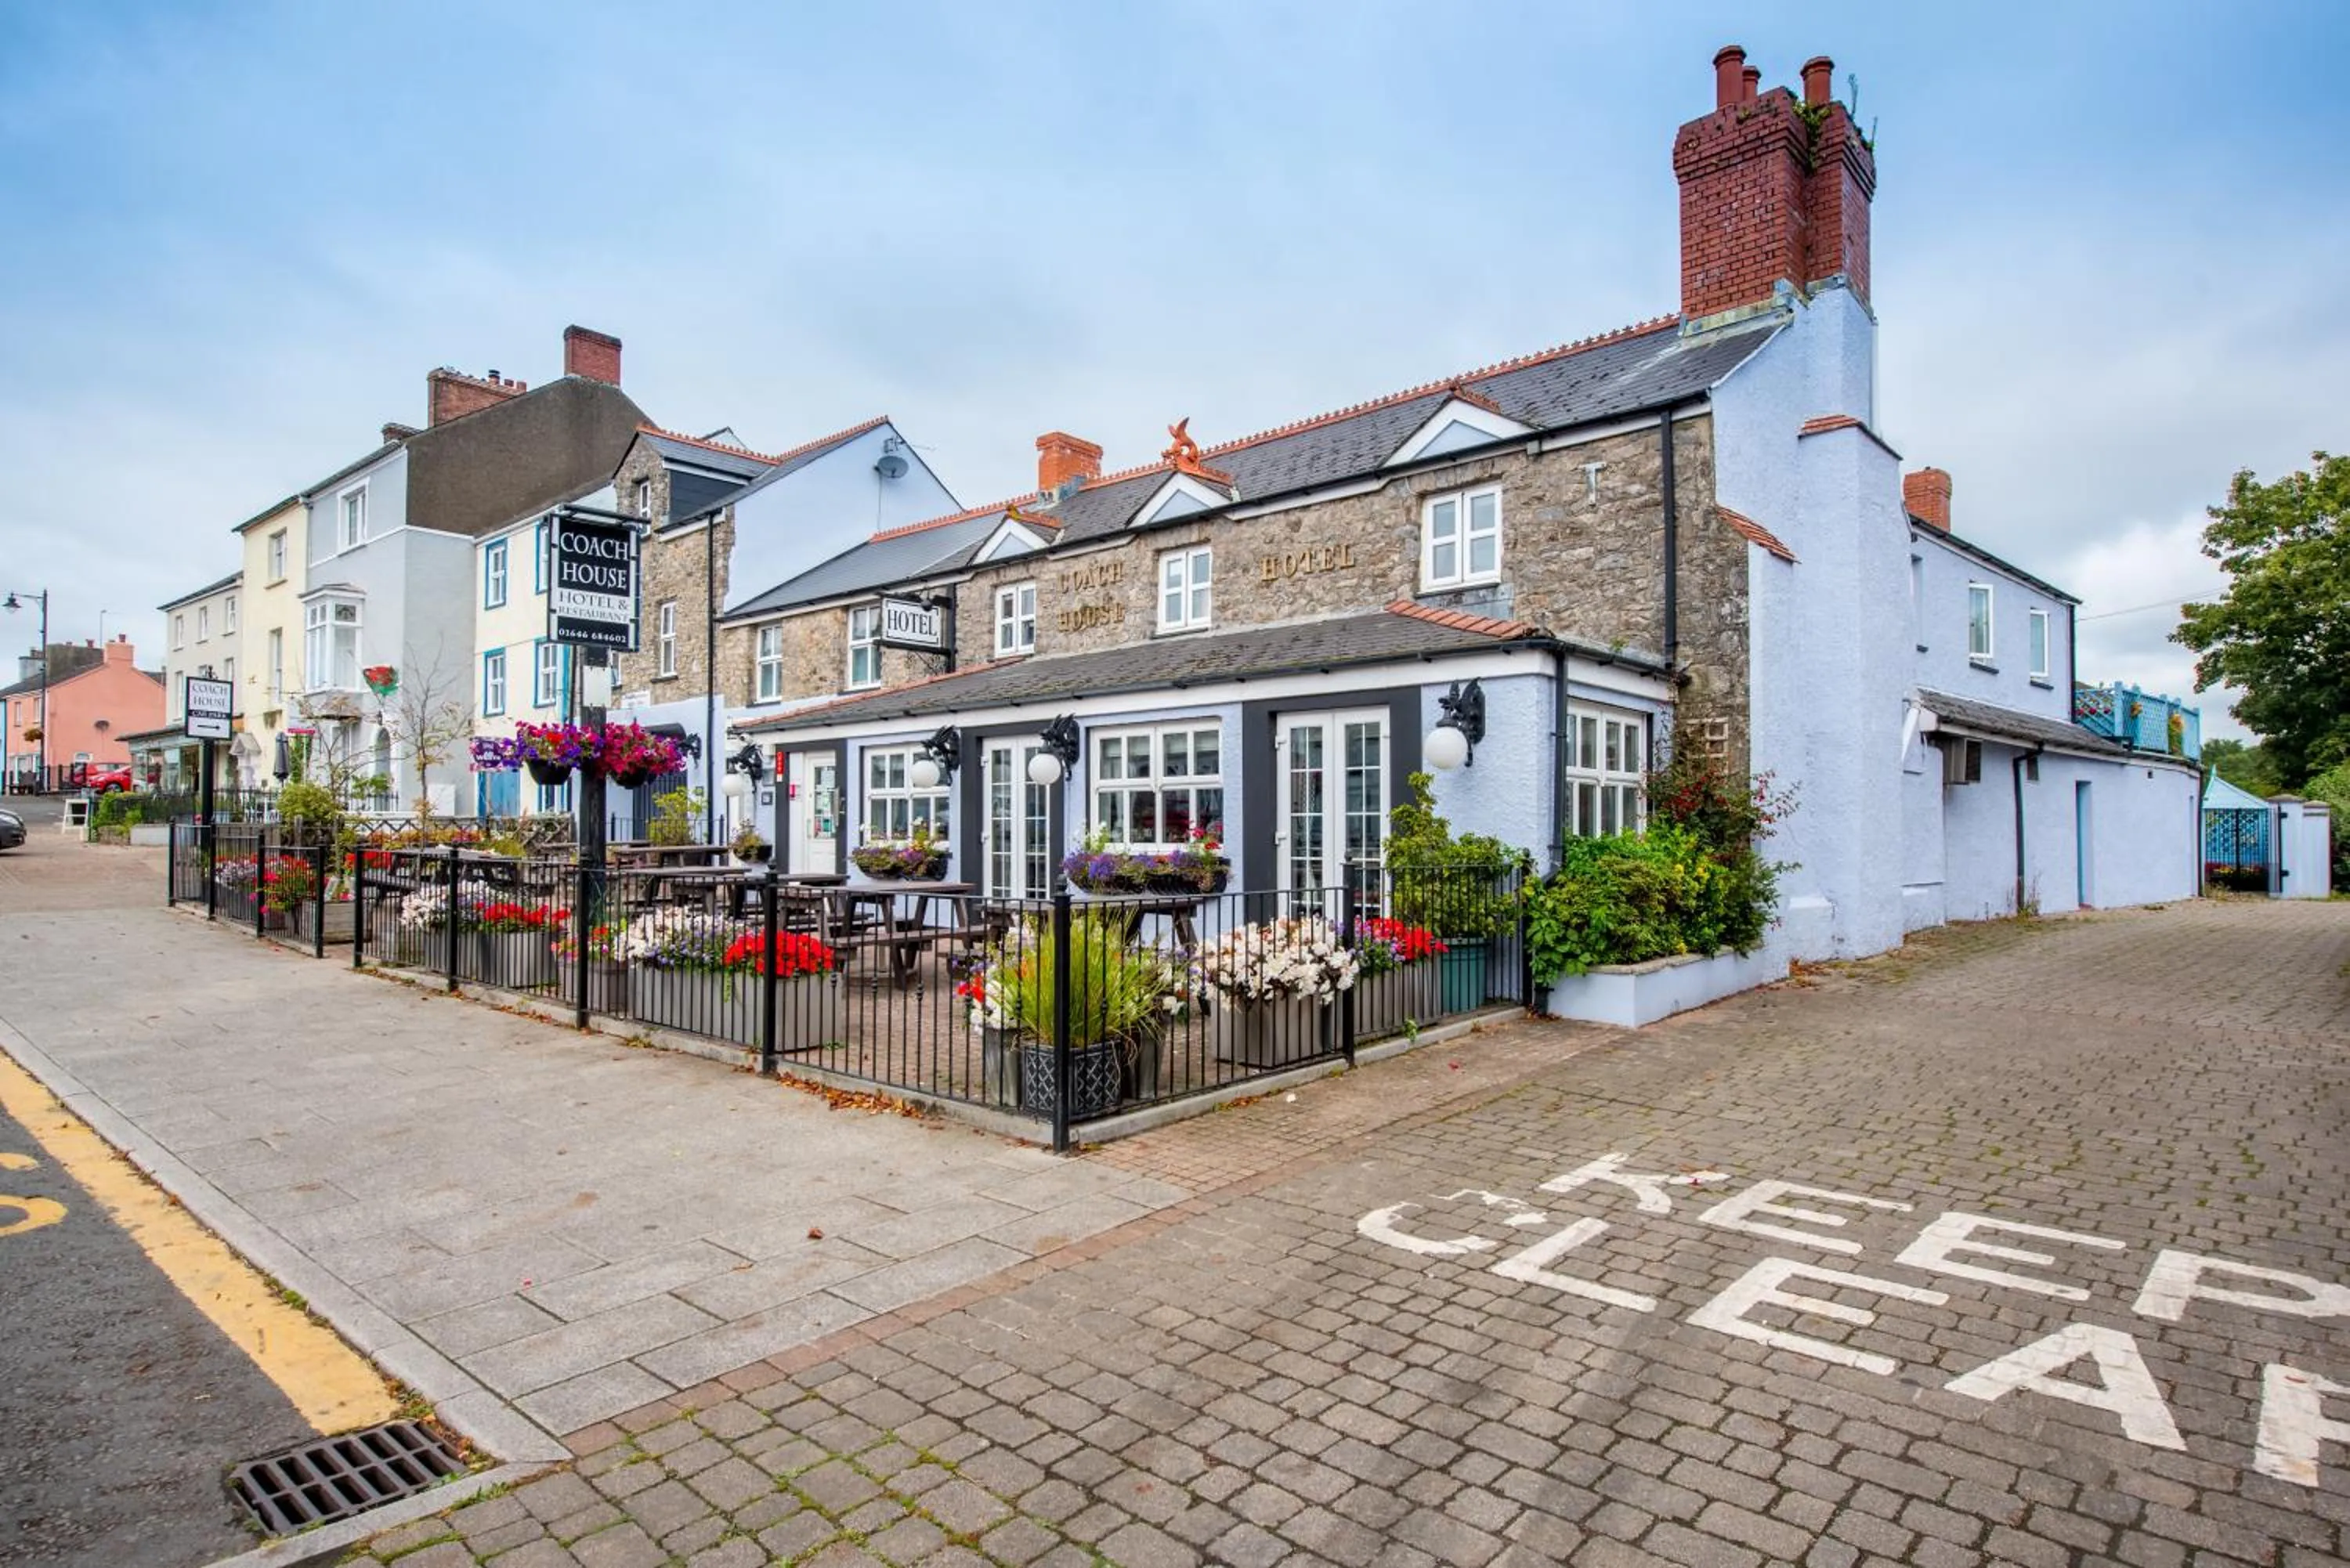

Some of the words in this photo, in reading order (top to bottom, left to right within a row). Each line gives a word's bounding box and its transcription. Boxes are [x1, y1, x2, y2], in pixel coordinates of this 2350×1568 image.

[560, 532, 628, 561] COACH
[561, 560, 627, 590] HOUSE
[1259, 544, 1356, 582] HOTEL
[1057, 561, 1125, 594] COACH
[558, 605, 628, 622] RESTAURANT
[559, 590, 615, 609] HOTEL
[618, 600, 628, 611] &
[888, 609, 938, 637] HOTEL
[1057, 602, 1126, 633] HOUSE
[559, 627, 588, 638] 01646
[192, 683, 228, 696] COACH
[193, 695, 226, 708] HOUSE
[1538, 1151, 2350, 1321] KEEP
